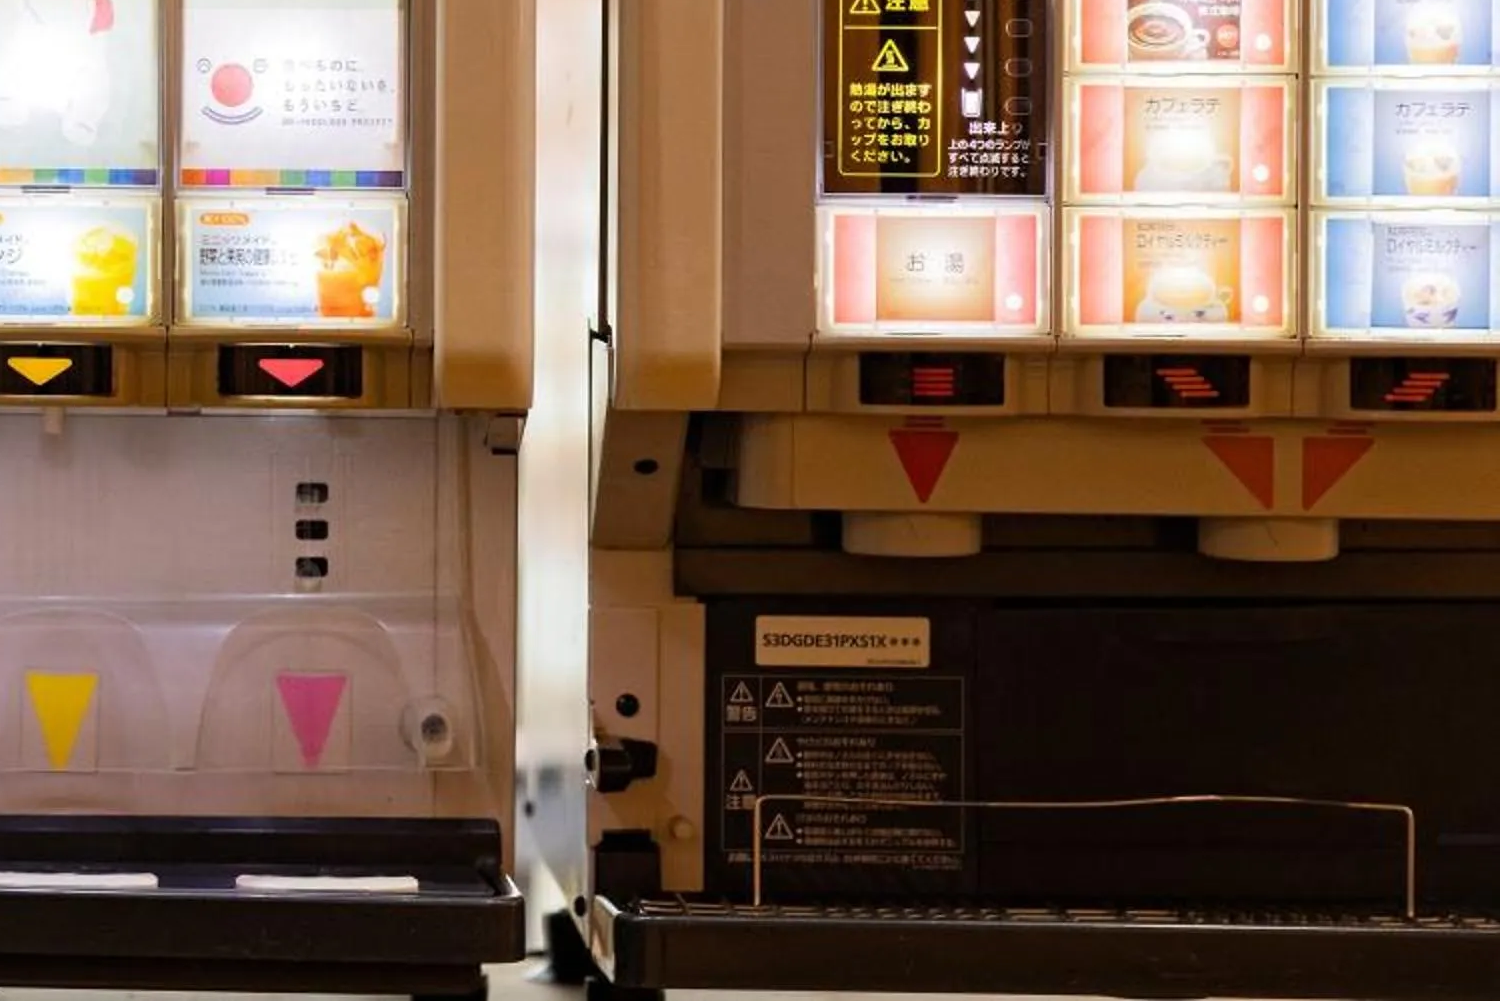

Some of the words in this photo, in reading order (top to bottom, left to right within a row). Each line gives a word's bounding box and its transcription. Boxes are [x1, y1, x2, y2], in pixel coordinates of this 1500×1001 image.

[849, 82, 932, 97] 熱湯が出ます
[849, 100, 932, 114] ので注ぎ終わ
[1144, 97, 1221, 114] カフェラテ
[1394, 101, 1472, 118] カフェラテ
[850, 116, 931, 131] ってから、カ
[968, 121, 1023, 135] 出来上り
[850, 133, 930, 147] ップをお取り
[850, 150, 912, 164] ください。
[906, 251, 965, 274] お湯
